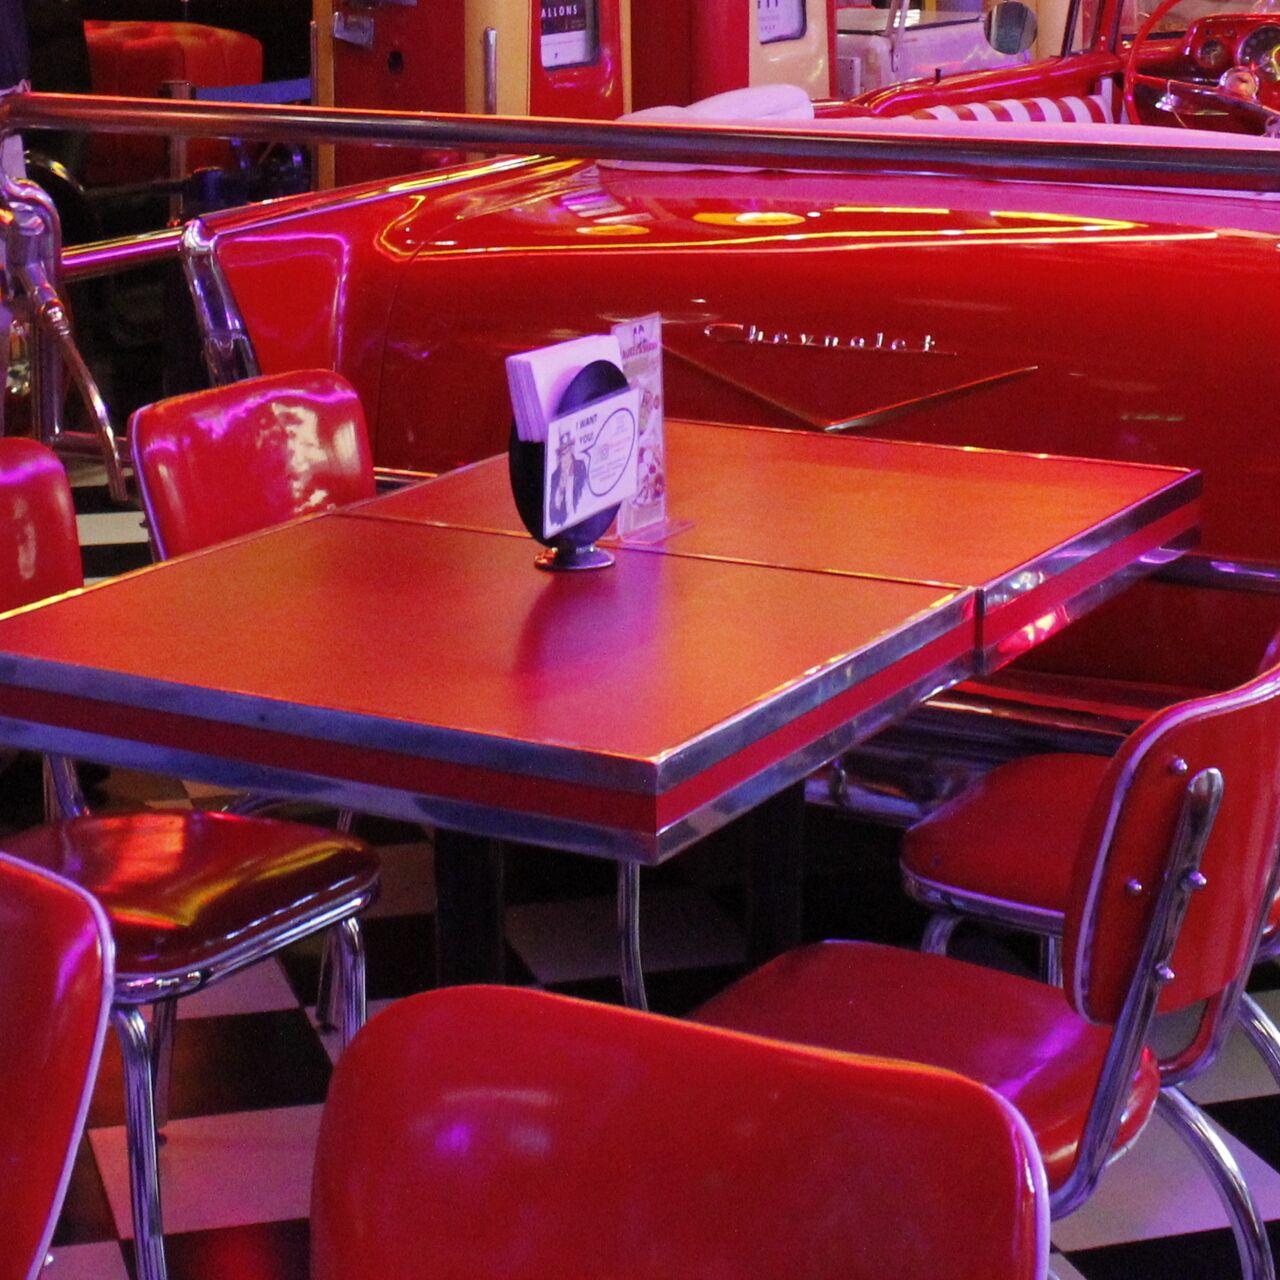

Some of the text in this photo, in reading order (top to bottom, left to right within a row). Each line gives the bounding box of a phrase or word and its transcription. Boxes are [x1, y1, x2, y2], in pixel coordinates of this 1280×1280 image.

[540, 4, 578, 19] ALLONS
[703, 322, 938, 353] Chevrolet
[580, 413, 600, 429] WANT
